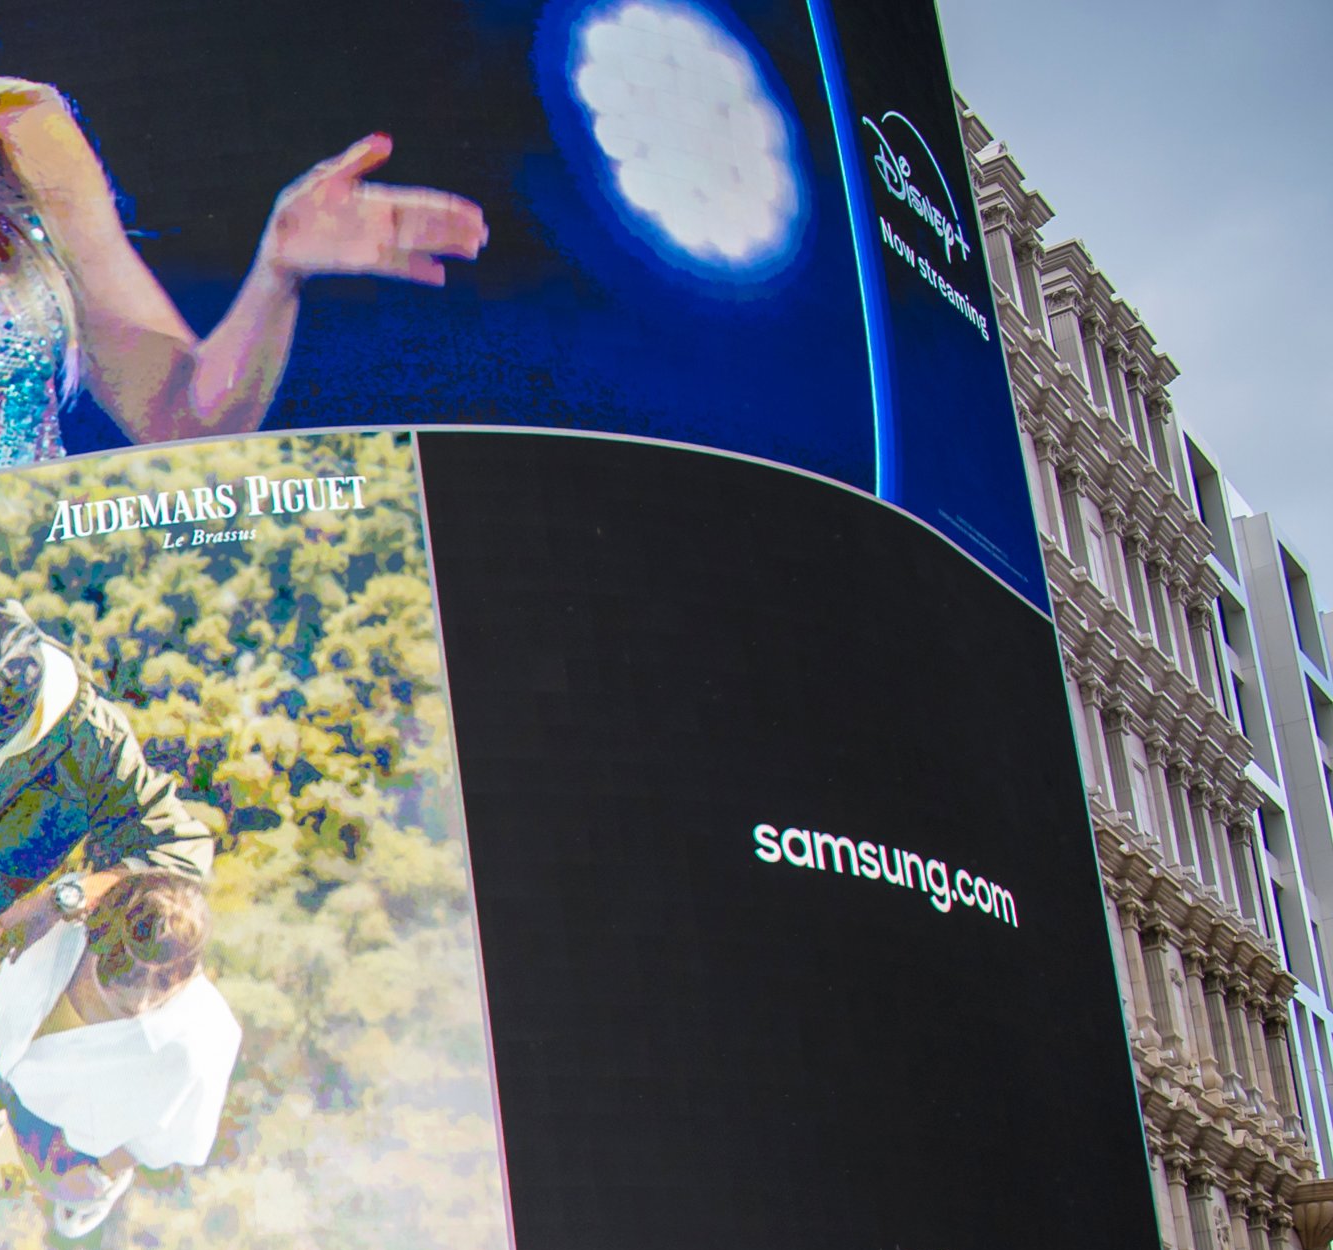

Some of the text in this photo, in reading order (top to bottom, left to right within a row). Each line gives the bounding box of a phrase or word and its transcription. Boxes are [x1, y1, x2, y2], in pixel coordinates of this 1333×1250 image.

[879, 215, 989, 341] Now streaming
[45, 475, 367, 542] AUDEMARS PIGUET
[162, 527, 257, 549] Le Brassus
[752, 823, 1019, 929] samsung.com
